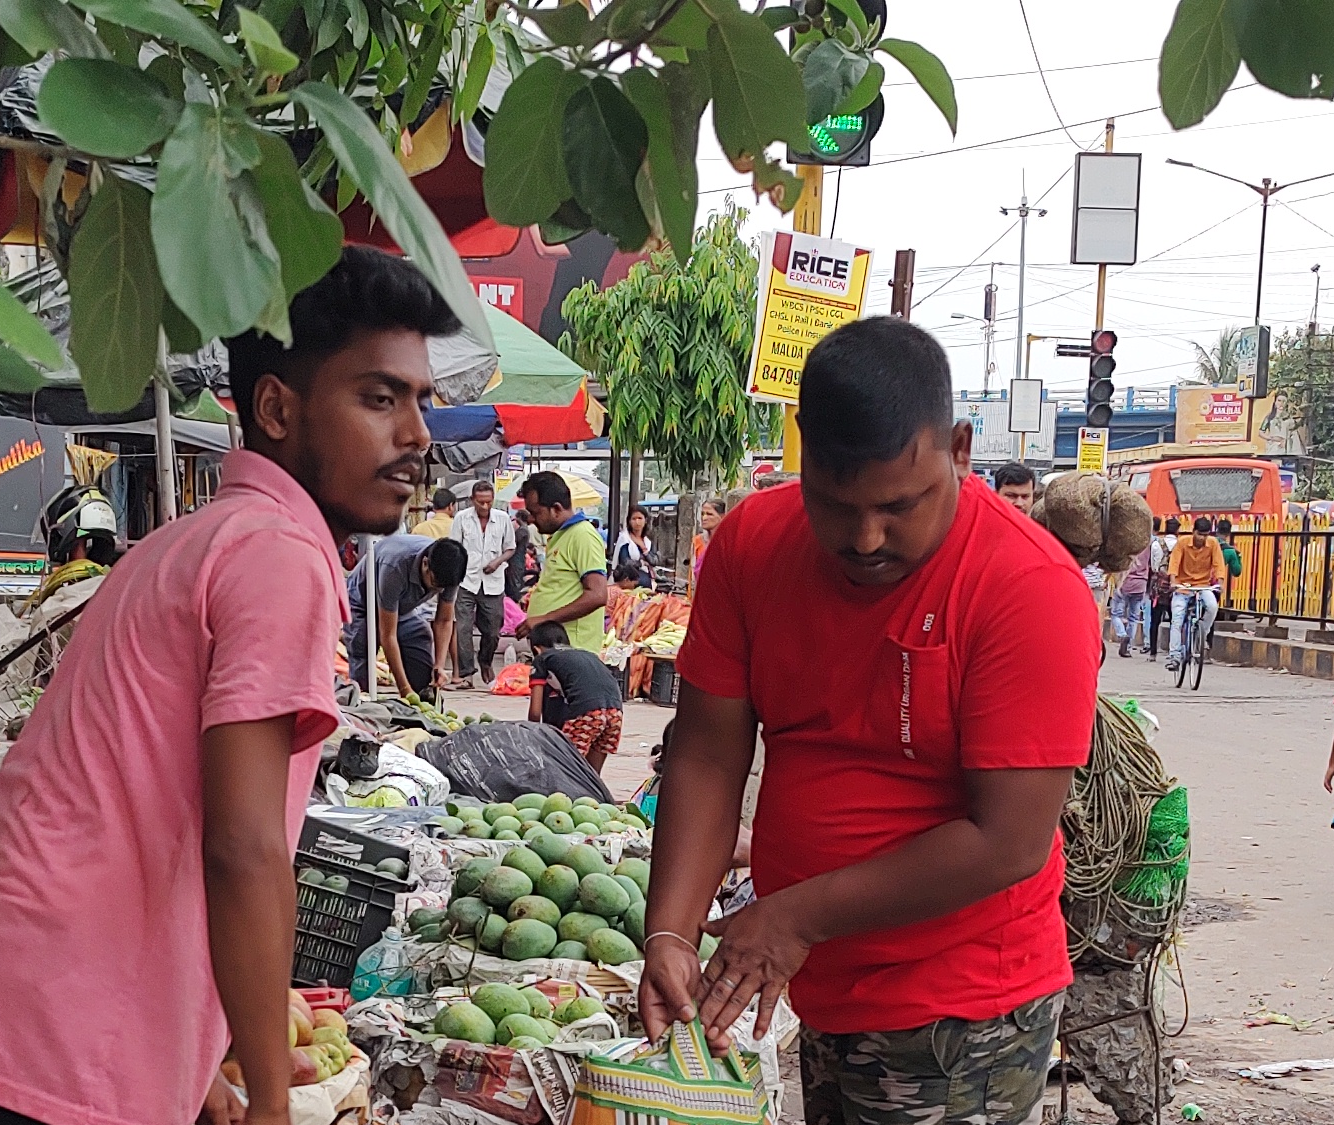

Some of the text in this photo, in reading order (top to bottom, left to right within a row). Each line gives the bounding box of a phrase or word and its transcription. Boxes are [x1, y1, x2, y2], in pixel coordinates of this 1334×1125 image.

[789, 272, 846, 291] EDUCATION
[478, 283, 515, 306] NT
[781, 299, 804, 312] WBCS
[771, 341, 803, 360] MALDA
[761, 363, 801, 386] 84799
